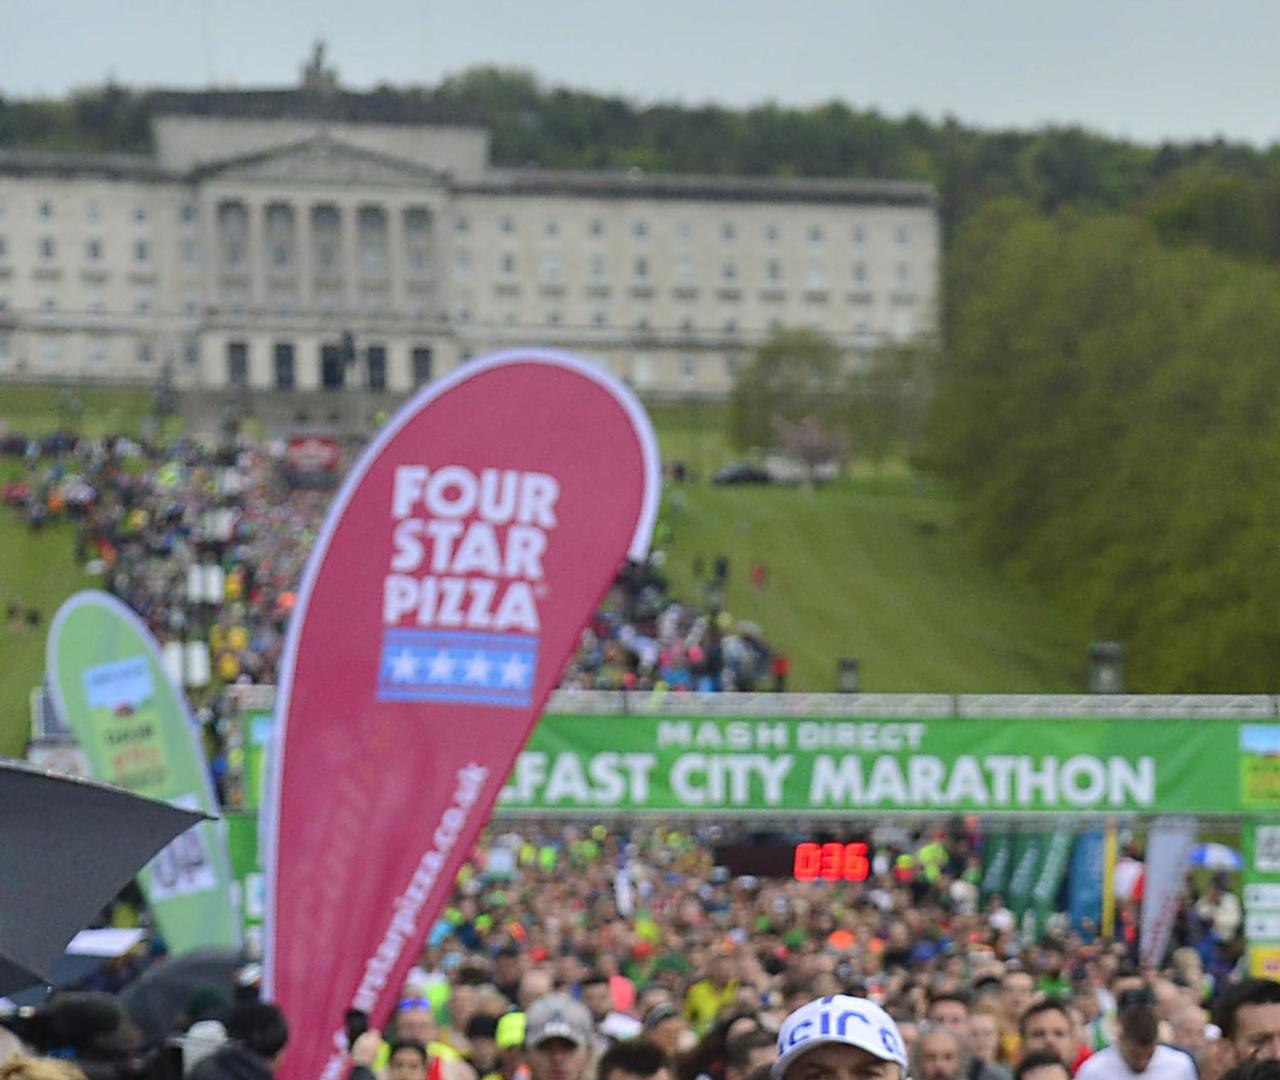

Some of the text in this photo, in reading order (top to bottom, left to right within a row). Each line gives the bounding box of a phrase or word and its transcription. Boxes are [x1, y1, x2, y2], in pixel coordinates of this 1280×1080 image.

[393, 465, 559, 528] FOUR
[391, 518, 547, 579] STAR
[383, 574, 541, 633] PIZZA
[656, 722, 924, 750] MASH DIRECT
[669, 753, 793, 806] CITY
[808, 755, 1155, 805] MARATHON
